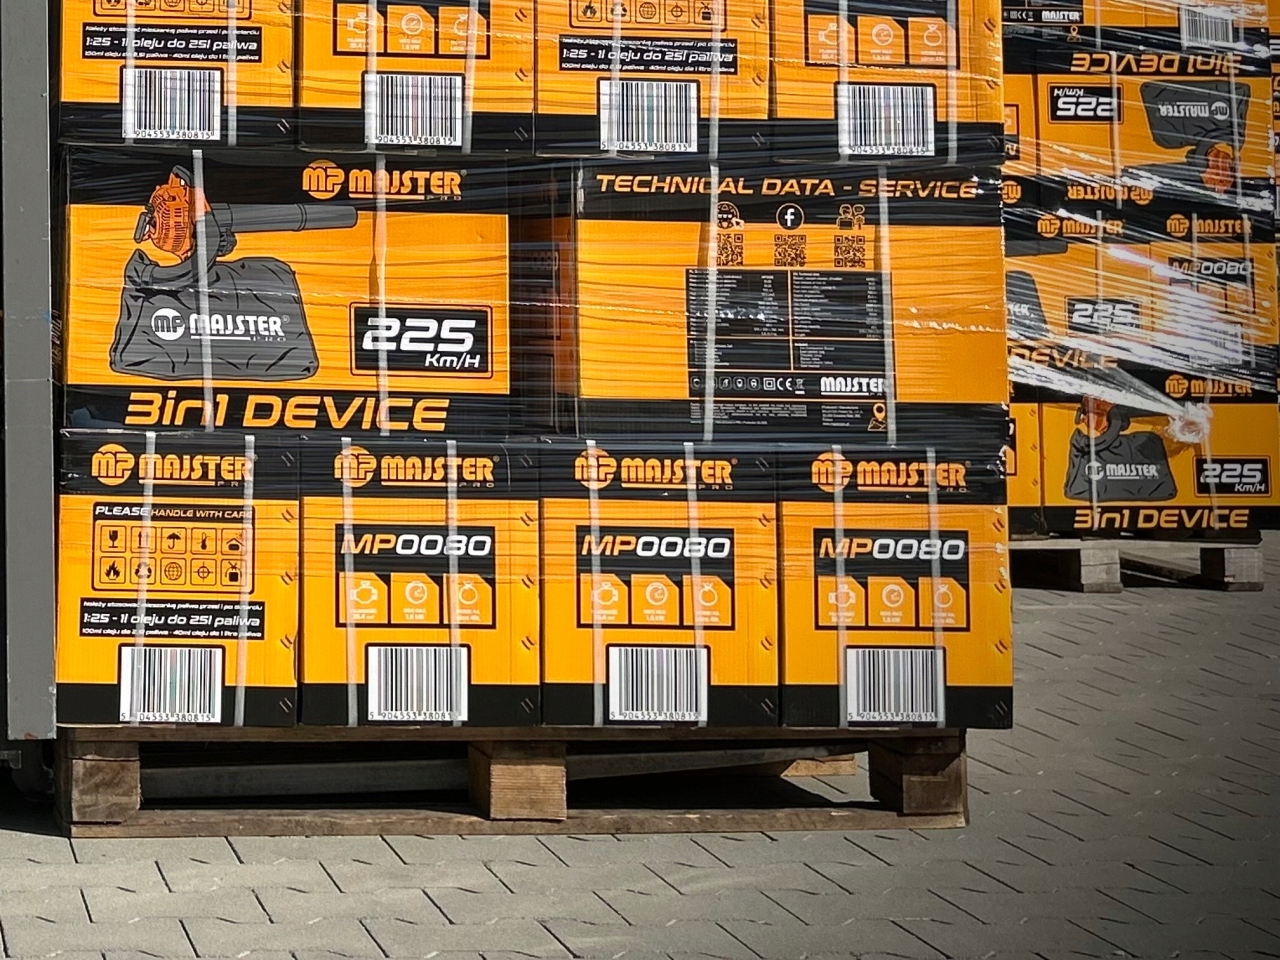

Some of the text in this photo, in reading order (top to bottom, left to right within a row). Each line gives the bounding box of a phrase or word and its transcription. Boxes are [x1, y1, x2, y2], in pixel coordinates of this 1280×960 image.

[1042, 11, 1080, 21] MAJSTER
[135, 129, 212, 140] 904553 380815
[378, 136, 453, 145] 904553 380815
[349, 170, 462, 195] MAJSTER
[761, 178, 835, 196] DATA
[859, 180, 977, 199] SERVICE
[190, 314, 284, 335] MAJSTER
[362, 318, 476, 352] 225
[425, 353, 480, 368] Km/H
[125, 392, 450, 432] 3in1 DEVICE
[138, 454, 251, 481] MAJSTER
[381, 456, 494, 481] MAJSTER
[621, 458, 732, 484] MAJSTER
[857, 461, 966, 487] MAJSTER
[1106, 464, 1157, 476] MAJSTER
[1200, 463, 1262, 483] 225
[1235, 483, 1265, 492] Km/H
[95, 506, 148, 517] PLEASE
[150, 509, 192, 518] HANDLE
[195, 510, 223, 518] WITH
[1074, 509, 1249, 528] 3in1 DEVICE
[341, 534, 491, 556] MP0080
[581, 536, 730, 558] MP0080
[820, 539, 965, 560] MP0080
[84, 613, 110, 622] 1:25
[168, 615, 185, 624] do
